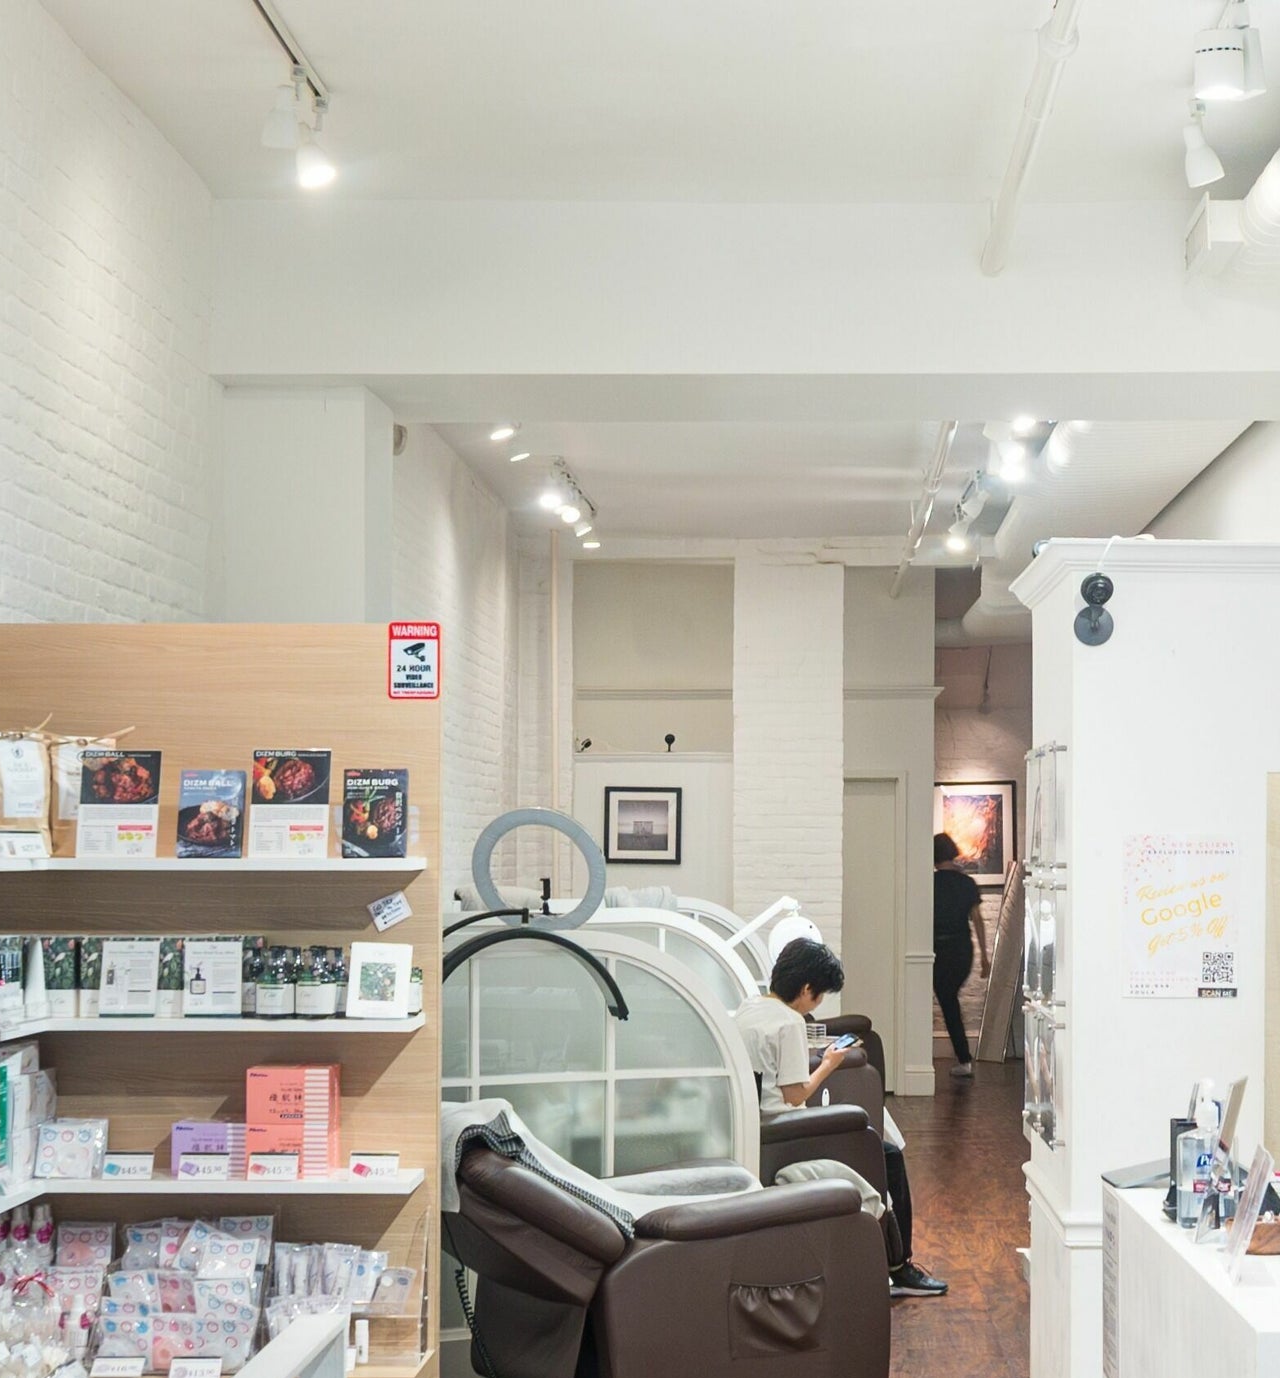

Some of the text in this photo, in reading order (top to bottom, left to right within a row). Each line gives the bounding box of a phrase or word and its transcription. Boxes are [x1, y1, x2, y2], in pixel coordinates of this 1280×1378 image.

[392, 625, 438, 637] WARNING
[346, 778, 399, 786] DIZM BURG
[1141, 892, 1222, 926] Google
[1202, 989, 1221, 997] SCAN
